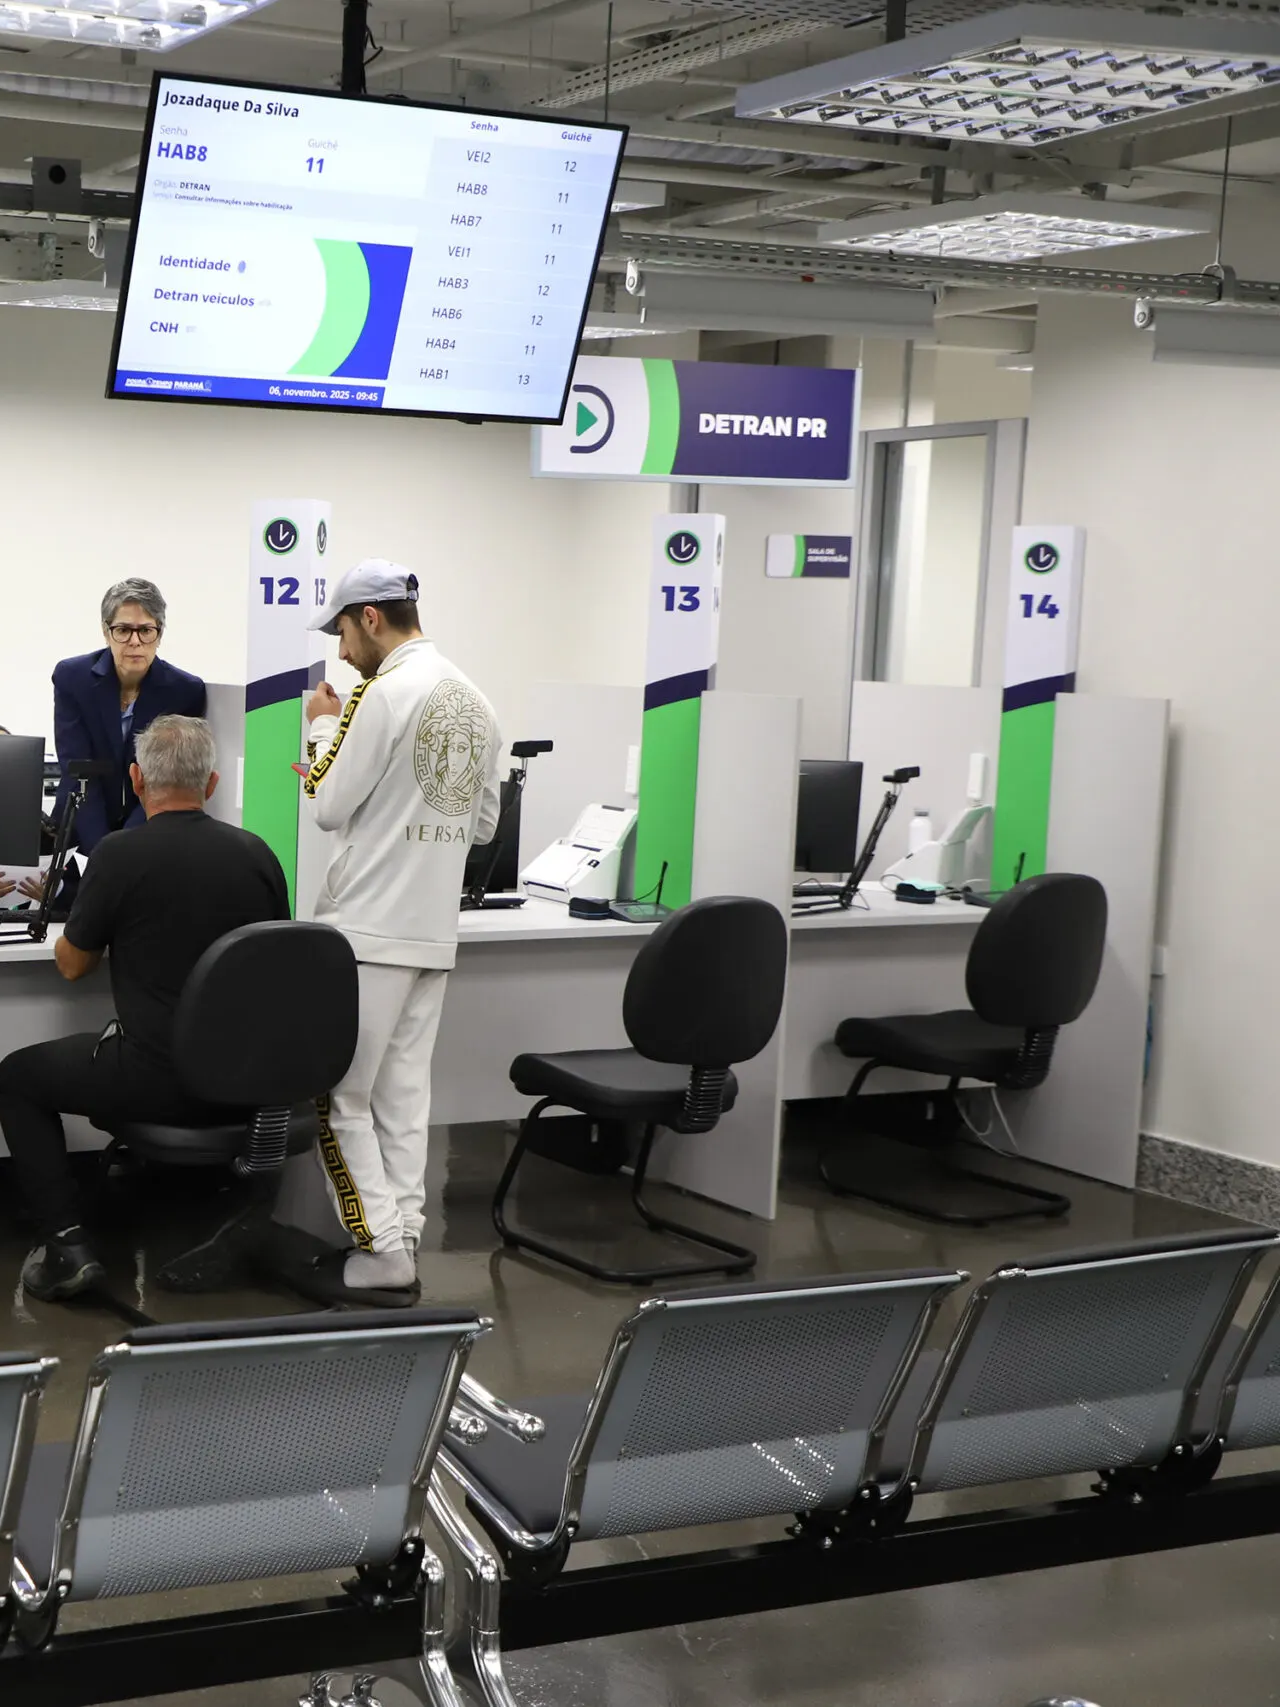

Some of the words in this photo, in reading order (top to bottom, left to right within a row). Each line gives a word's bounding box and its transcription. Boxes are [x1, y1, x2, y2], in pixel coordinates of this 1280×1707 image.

[163, 91, 240, 112] Jozadaque
[244, 100, 262, 114] Da
[265, 102, 300, 118] Silva
[160, 124, 188, 137] Senha
[470, 121, 499, 132] Senha
[157, 142, 208, 162] HAB8
[467, 150, 491, 164] VEI2
[305, 157, 325, 174] 11
[564, 161, 577, 173] 12
[179, 181, 211, 191] DETRAN
[457, 182, 488, 196] HAB8
[557, 192, 569, 204] 11
[450, 214, 482, 227] HAB7
[551, 223, 562, 235] 11
[448, 245, 470, 258] VEI1
[159, 255, 231, 271] Identidade
[544, 254, 555, 265] 11
[438, 276, 469, 290] HAB3
[154, 288, 198, 302] Detran
[538, 285, 550, 296] 12
[432, 307, 462, 320] HAB6
[531, 315, 543, 326] 12
[150, 321, 179, 334] CNH
[425, 338, 456, 350] HAB4
[524, 345, 536, 356] 11
[419, 368, 449, 380] HAB1
[518, 374, 530, 385] 13
[269, 386, 281, 396] 06,
[330, 390, 350, 400] 2025
[356, 392, 379, 402] 09:45
[699, 413, 792, 437] DETRAN
[797, 417, 827, 438] PR
[260, 577, 300, 605] 12
[314, 578, 326, 606] 13
[661, 586, 700, 612] 13
[1020, 594, 1060, 619] 14
[406, 824, 466, 844] VERSA
